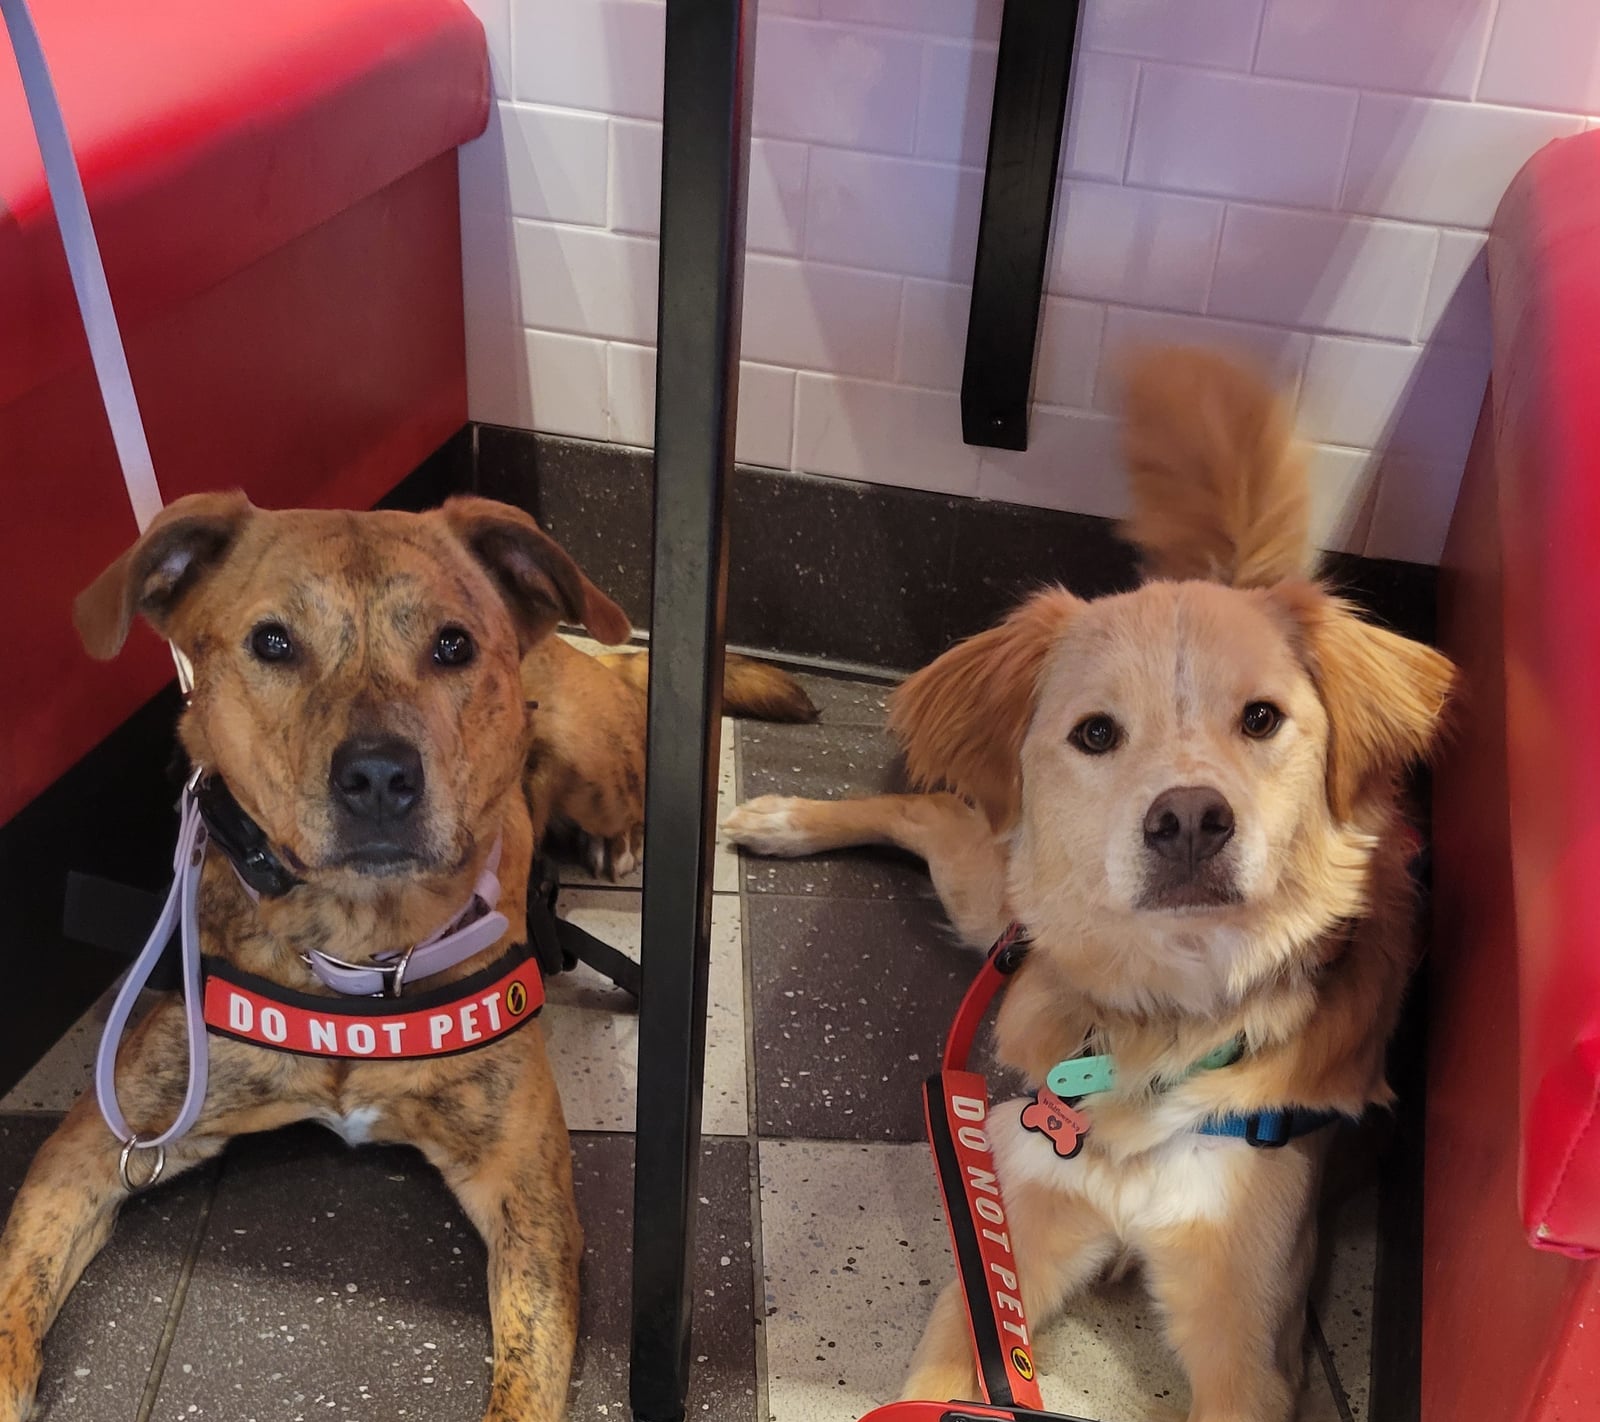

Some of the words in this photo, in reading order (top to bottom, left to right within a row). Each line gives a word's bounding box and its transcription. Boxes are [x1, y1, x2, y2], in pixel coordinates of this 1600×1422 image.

[230, 993, 287, 1042] DO
[309, 1018, 406, 1055] NOT
[429, 991, 501, 1050] PET
[952, 1095, 989, 1152] DO
[1043, 1098, 1072, 1124] Wildflower
[967, 1166, 1010, 1253] NOT
[991, 1263, 1029, 1345] PET
